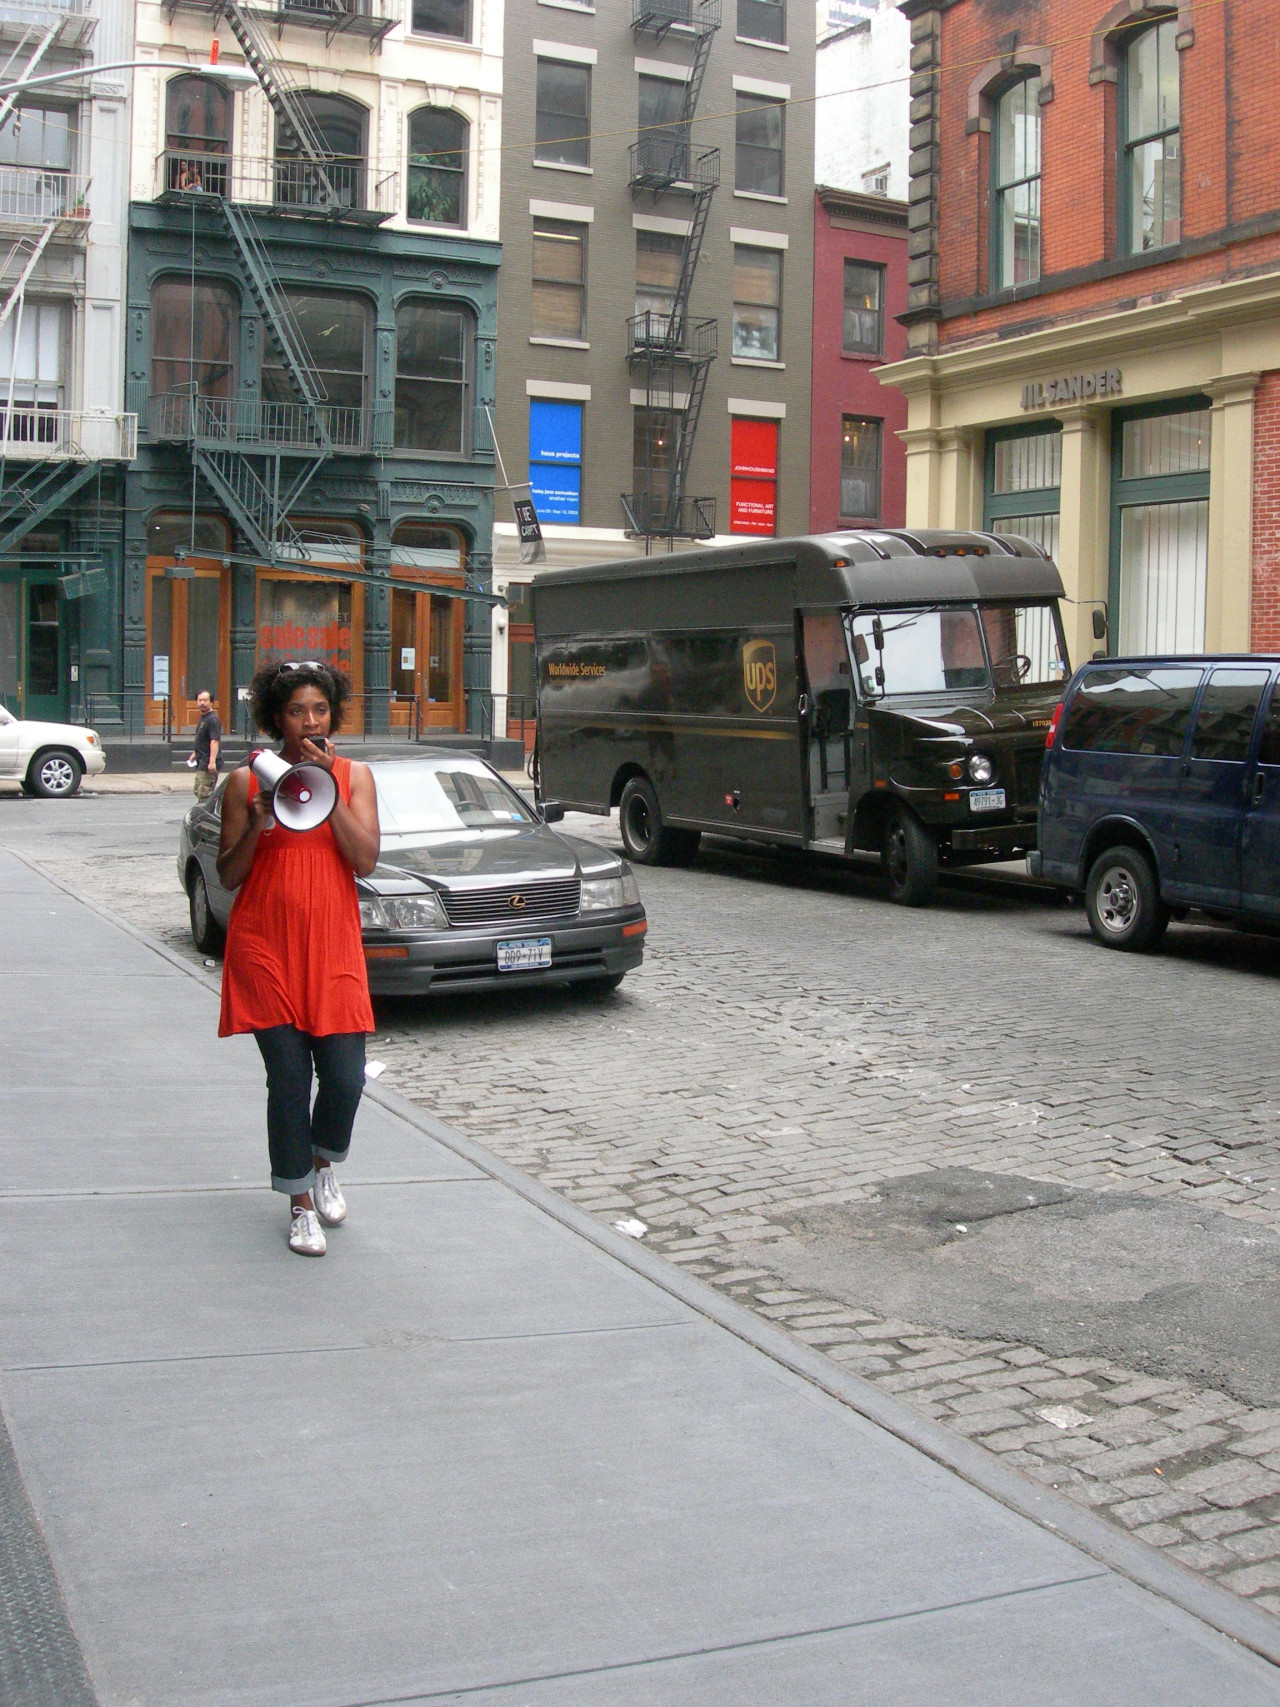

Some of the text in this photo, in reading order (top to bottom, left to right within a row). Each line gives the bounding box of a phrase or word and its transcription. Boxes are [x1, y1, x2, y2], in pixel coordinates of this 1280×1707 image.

[1020, 368, 1122, 408] JIL SANDER
[260, 620, 351, 650] sale sale
[548, 662, 606, 676] Worldwide Services
